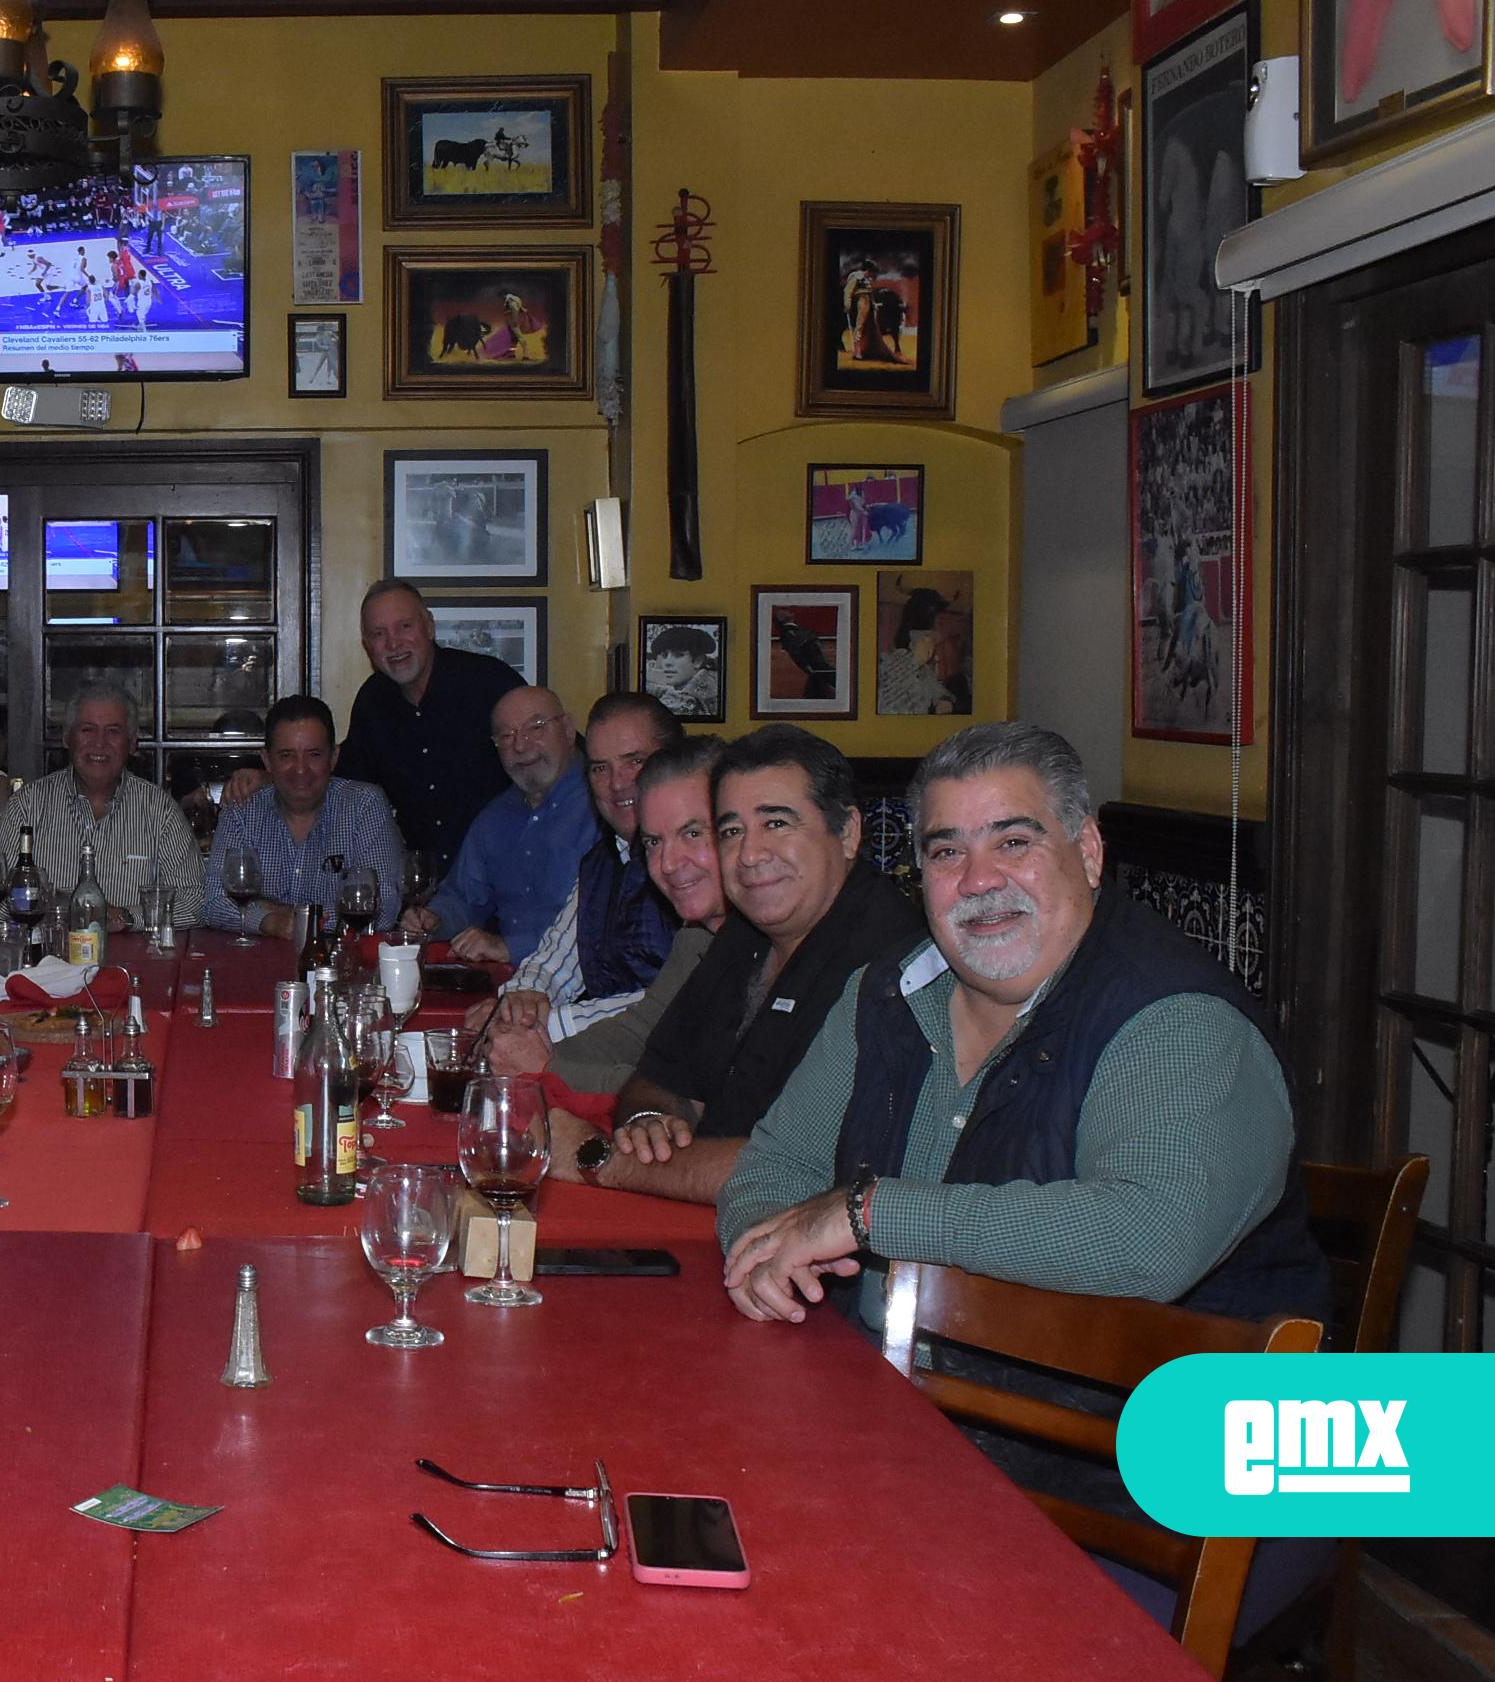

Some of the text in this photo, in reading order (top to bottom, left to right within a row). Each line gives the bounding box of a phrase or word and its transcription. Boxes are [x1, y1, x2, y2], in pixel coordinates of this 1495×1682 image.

[152, 263, 192, 291] ULTRA
[2, 334, 170, 344] Cleveland Cavaliers 55-62 Philadelphia 76ers
[71, 344, 95, 352] tiempo
